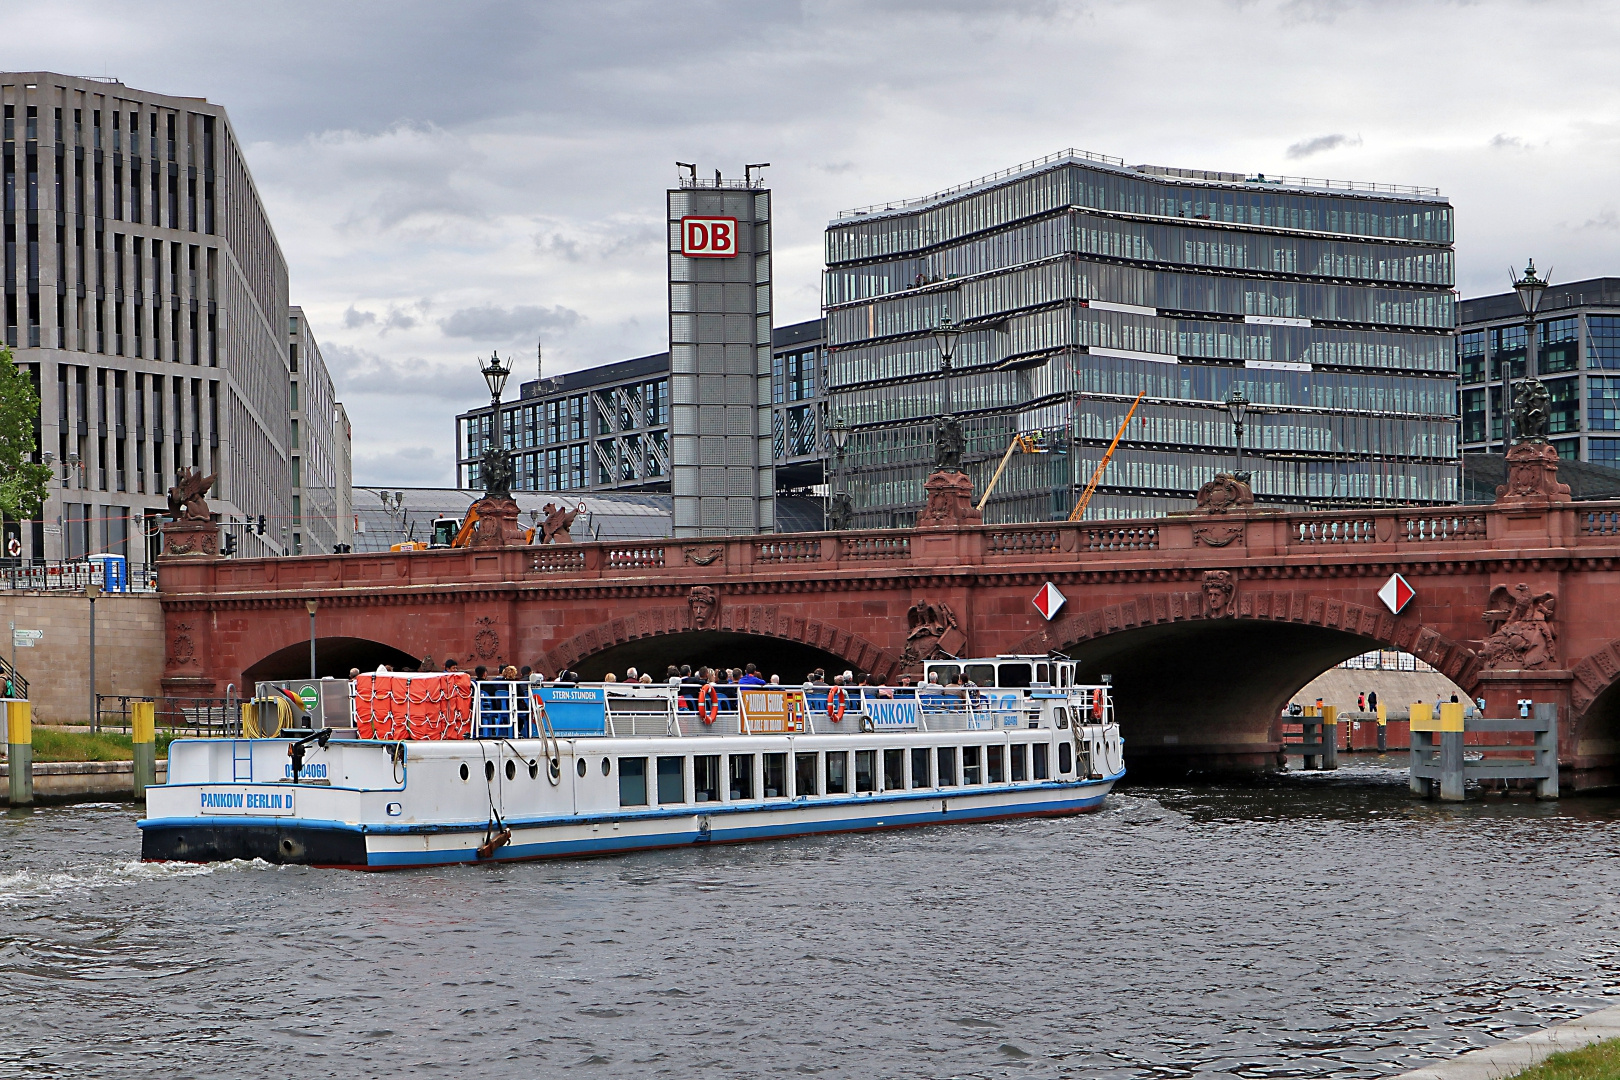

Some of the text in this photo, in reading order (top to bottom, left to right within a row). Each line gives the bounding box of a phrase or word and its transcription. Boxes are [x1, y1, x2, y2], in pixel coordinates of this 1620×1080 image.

[688, 223, 731, 251] DB
[552, 690, 596, 700] STERN-STUNDEN
[749, 693, 784, 712] AUDIO GUIDE
[865, 703, 916, 724] PANKOW
[201, 792, 293, 809] PANKOW BERLIN D
